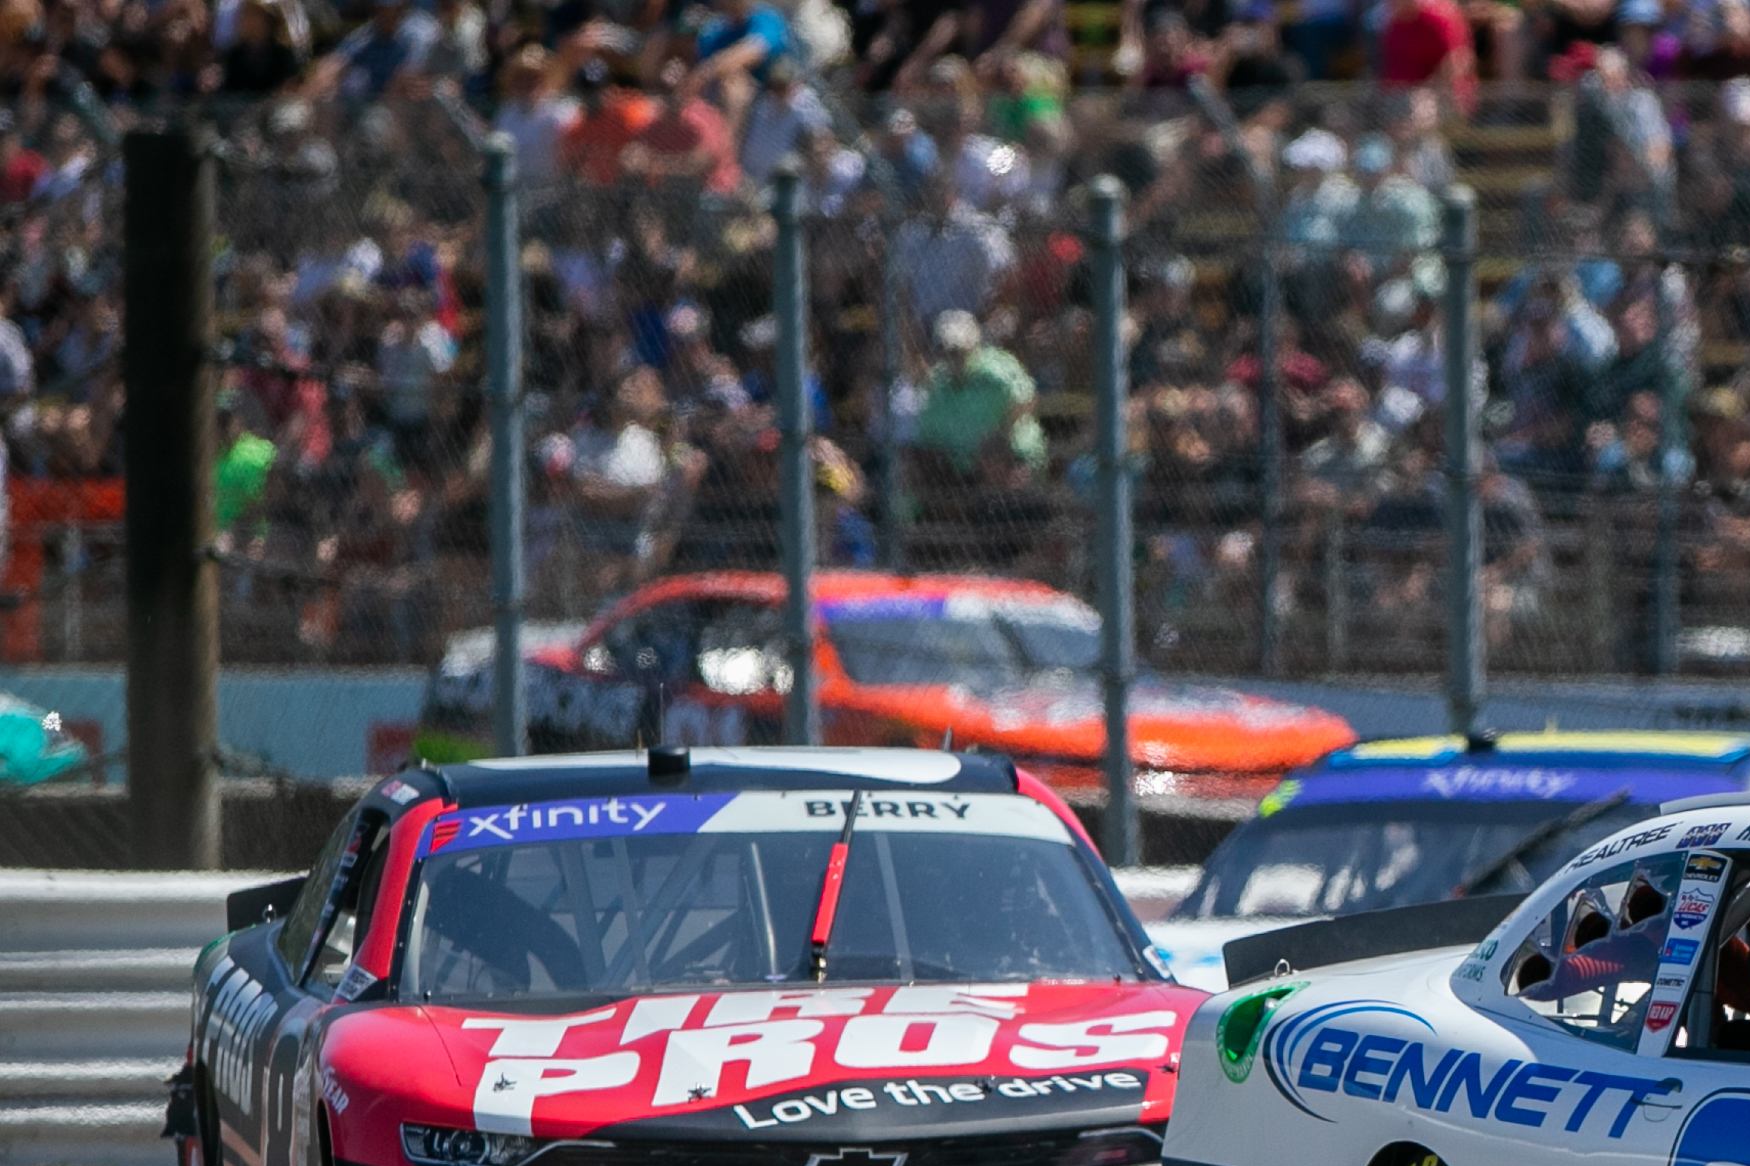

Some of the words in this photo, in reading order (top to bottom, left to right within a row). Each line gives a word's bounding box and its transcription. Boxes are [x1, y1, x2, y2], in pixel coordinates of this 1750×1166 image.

[1422, 765, 1577, 798] xfinity
[469, 799, 667, 839] xfinity
[806, 800, 970, 820] BERRY
[1677, 901, 1710, 913] LUCAS
[461, 984, 1029, 1057] TIRE
[473, 1010, 1177, 1137] PROS
[1298, 1027, 1671, 1139] BENNETT
[733, 1083, 876, 1130] Love
[884, 1078, 986, 1106] the
[998, 1072, 1142, 1098] drive
